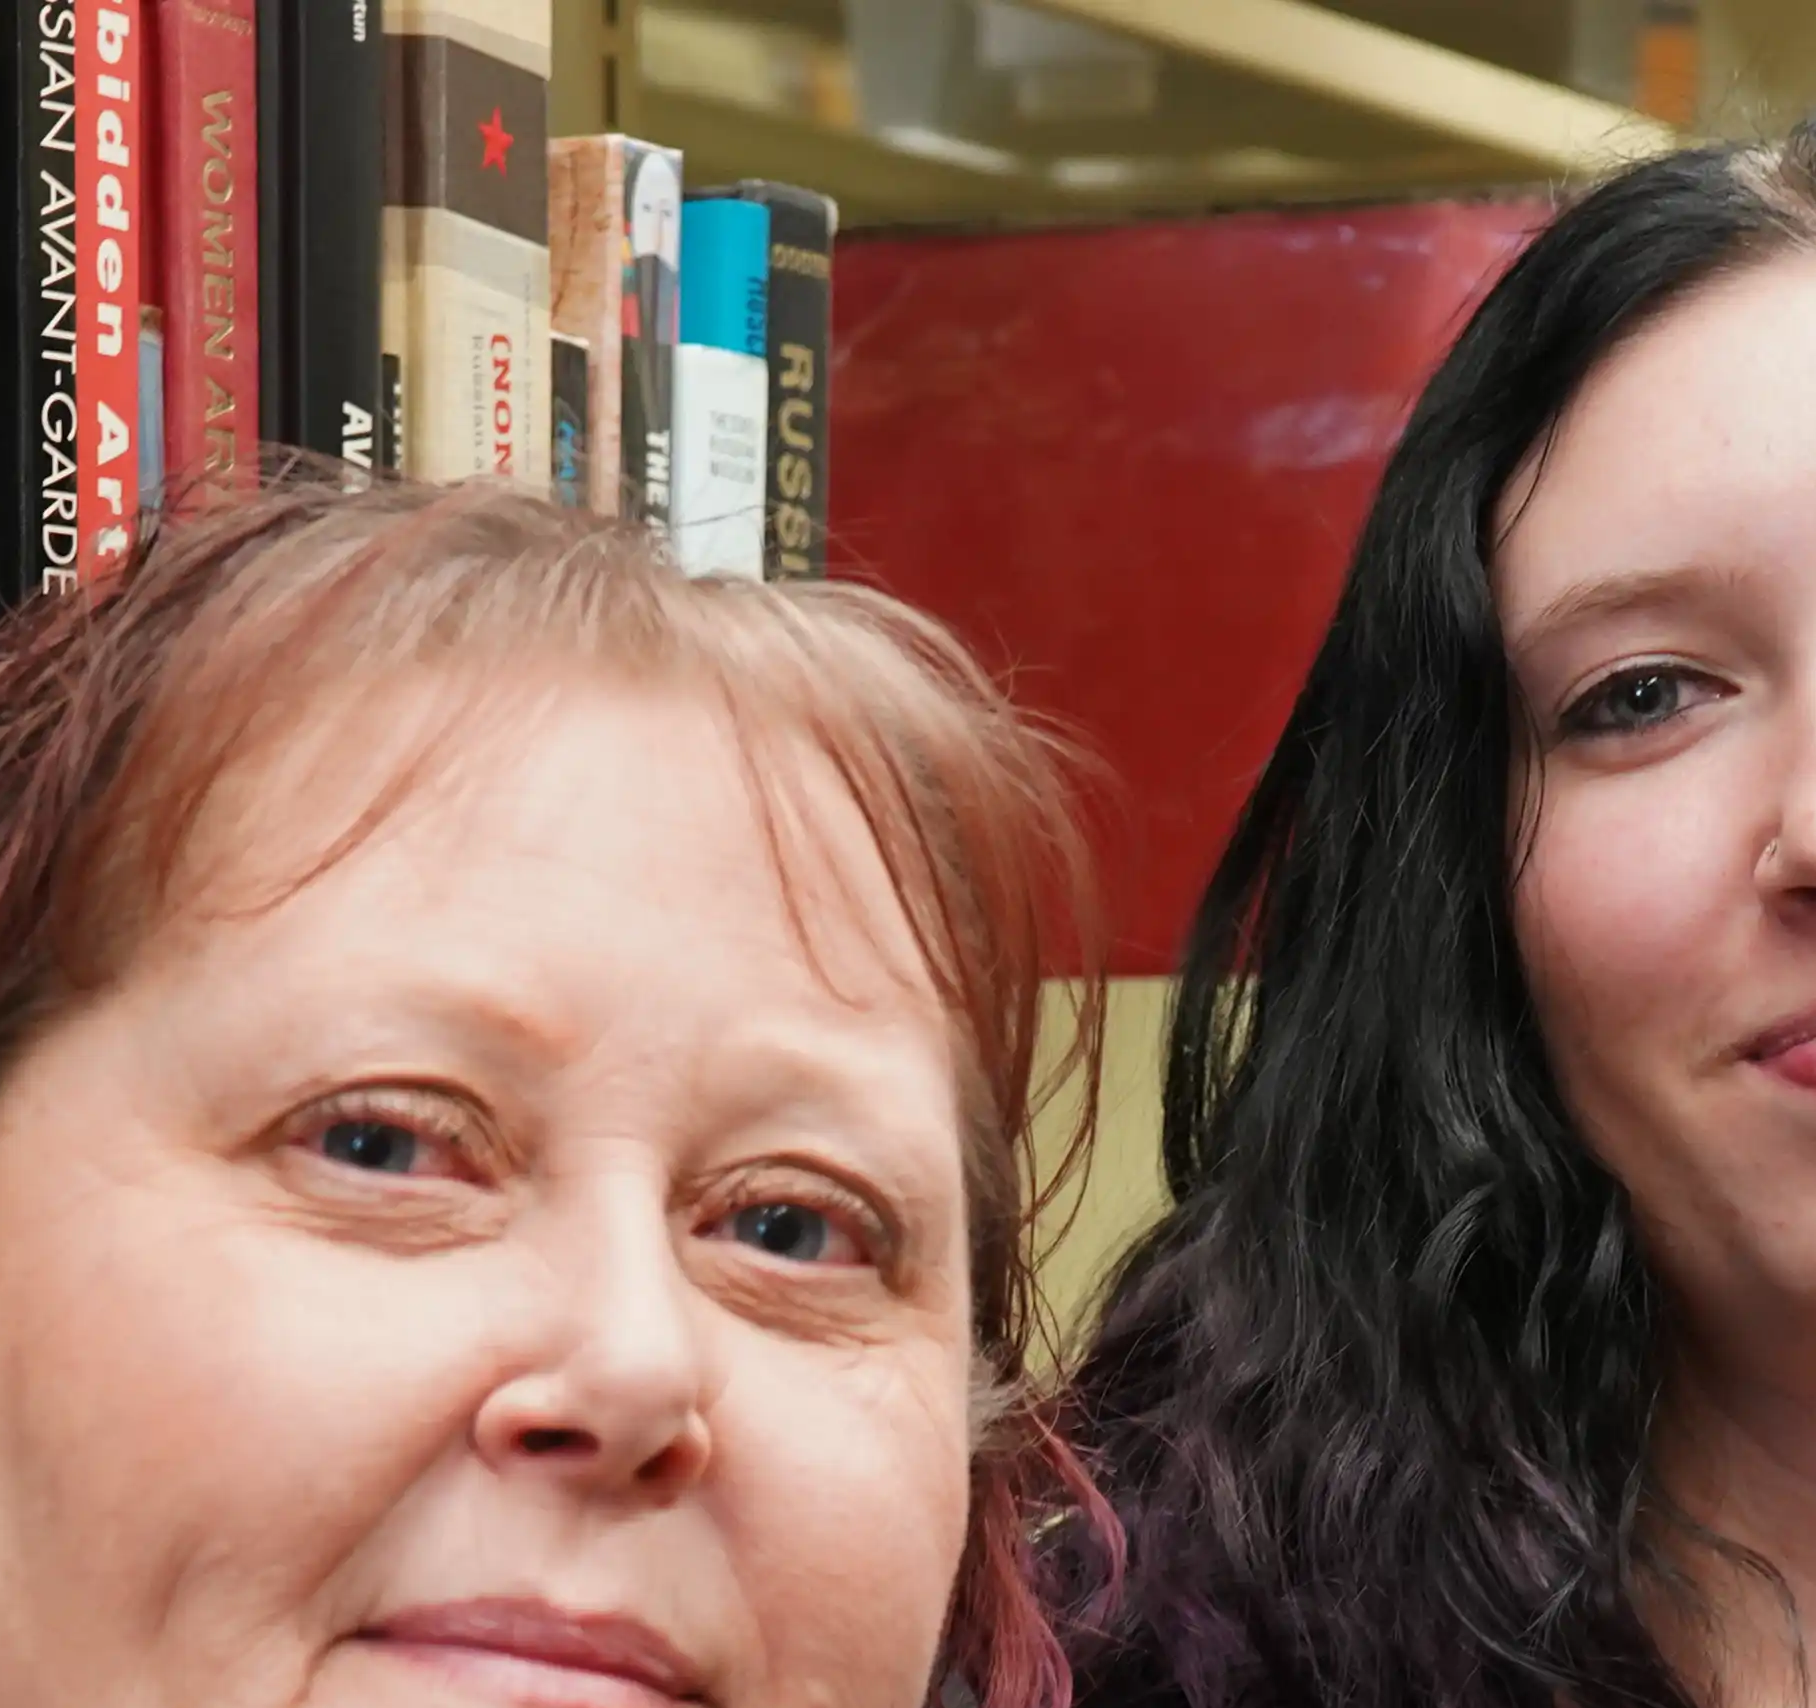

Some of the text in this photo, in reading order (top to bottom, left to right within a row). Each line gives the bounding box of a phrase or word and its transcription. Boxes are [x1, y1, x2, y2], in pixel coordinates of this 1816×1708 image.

[39, 0, 78, 596] SIAN AVANT-GARDE
[95, 0, 131, 558] bidden Art
[200, 90, 235, 363] WOMEN
[645, 428, 670, 508] THE
